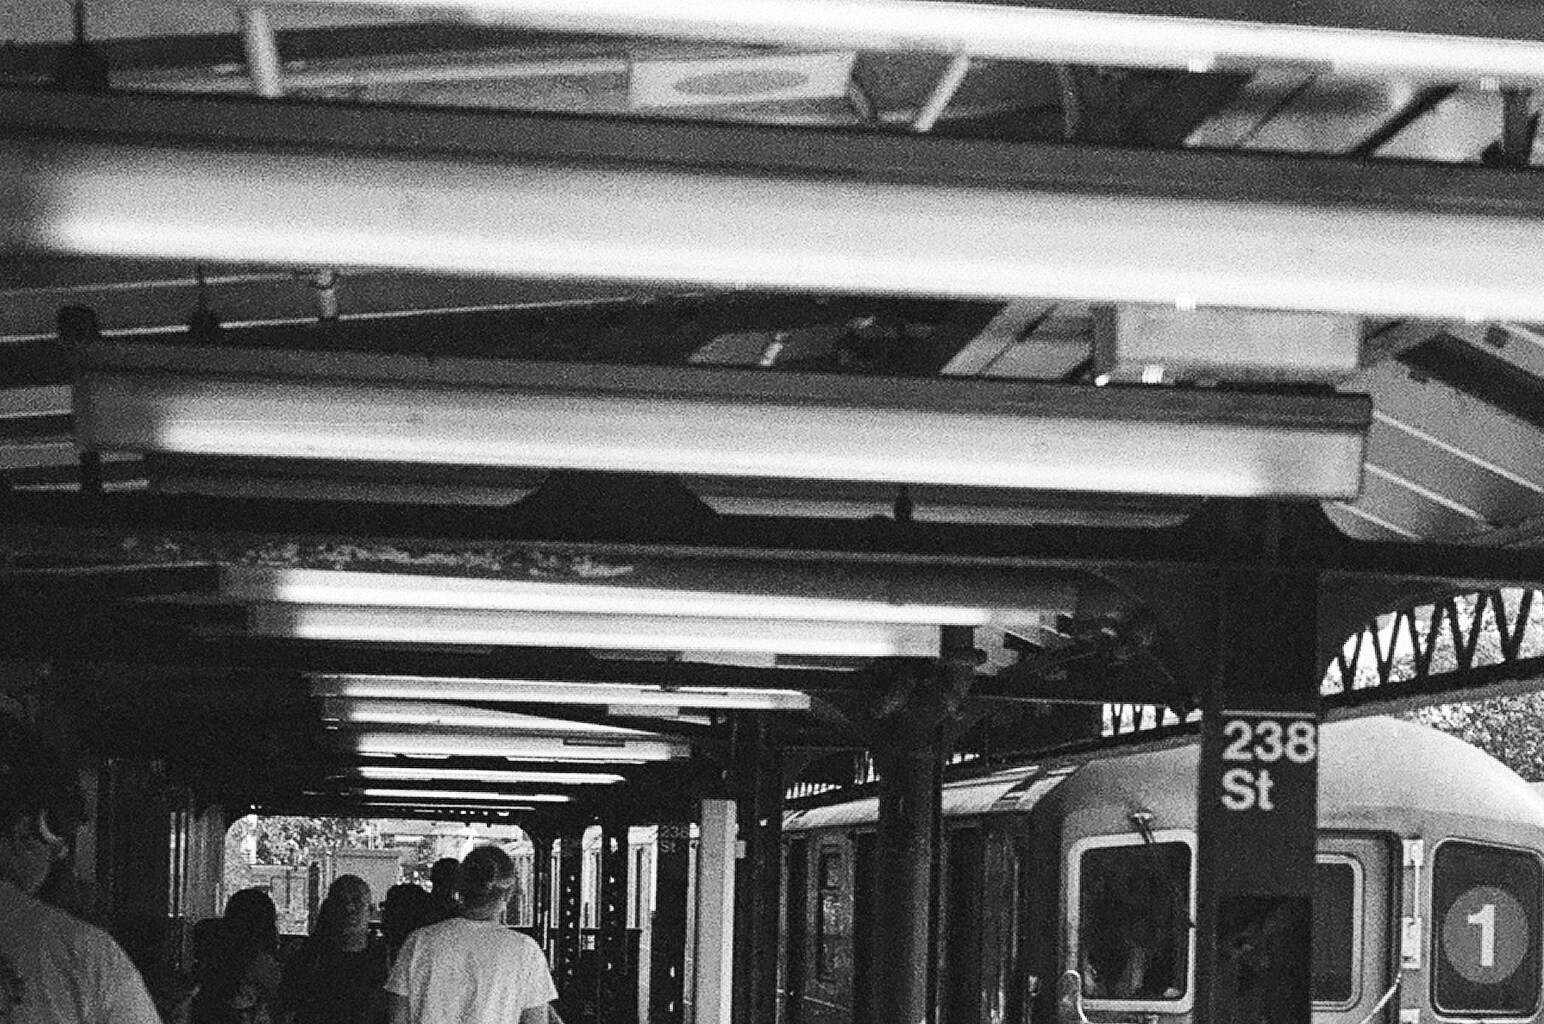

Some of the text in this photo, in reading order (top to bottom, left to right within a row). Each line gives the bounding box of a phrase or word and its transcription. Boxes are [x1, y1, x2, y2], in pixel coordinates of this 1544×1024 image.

[1222, 720, 1316, 763] 238
[1221, 768, 1275, 811] St
[1467, 903, 1495, 967] 1
